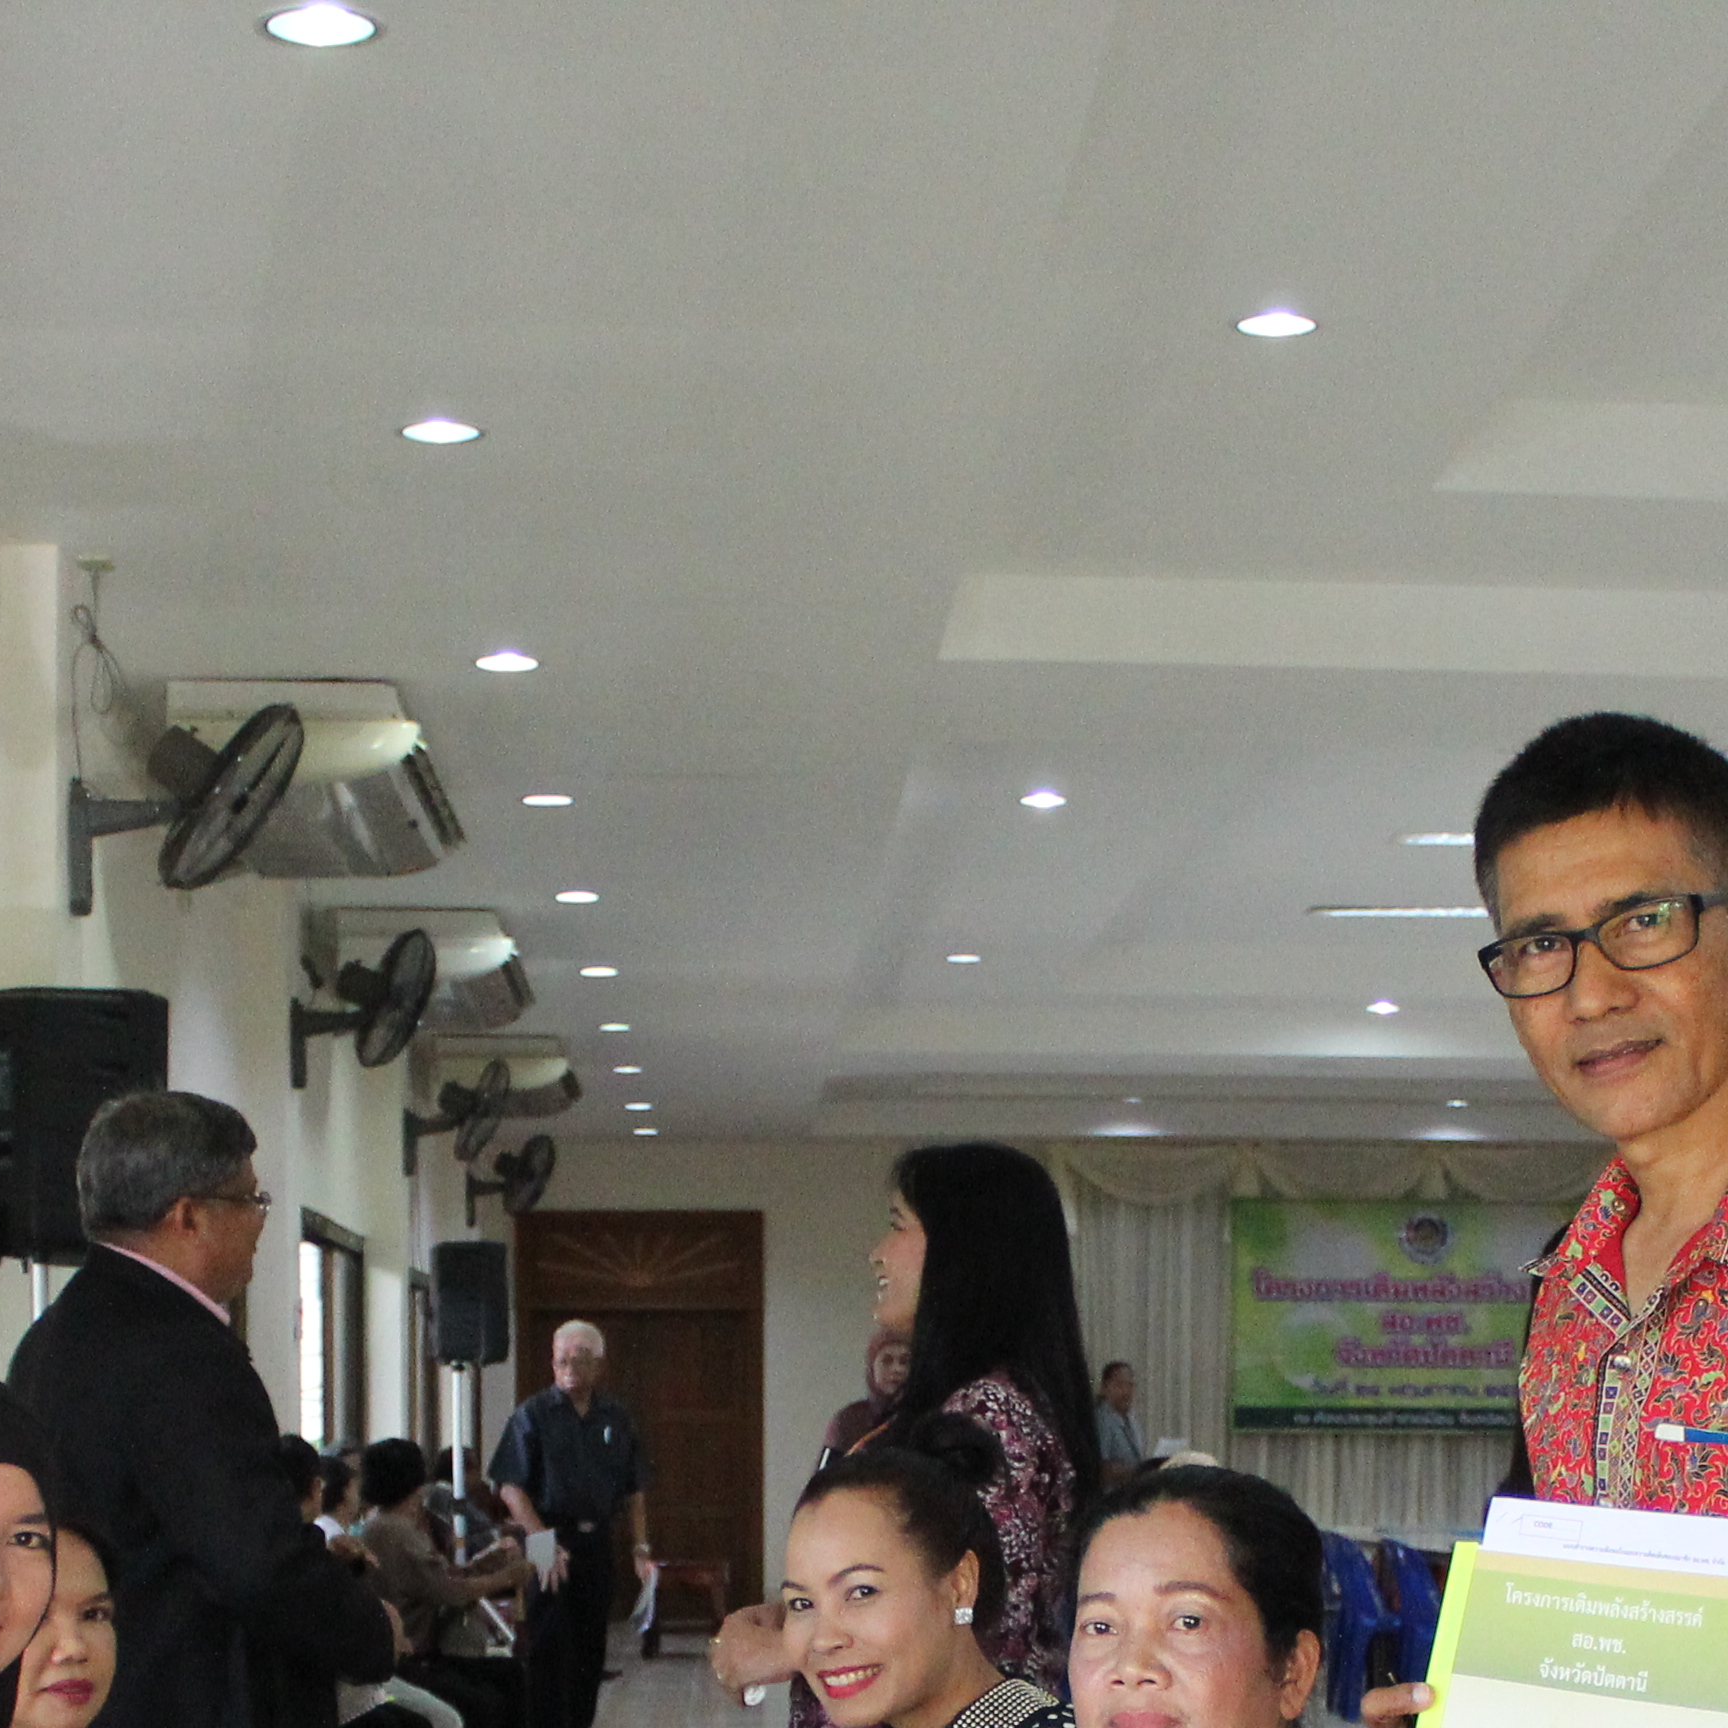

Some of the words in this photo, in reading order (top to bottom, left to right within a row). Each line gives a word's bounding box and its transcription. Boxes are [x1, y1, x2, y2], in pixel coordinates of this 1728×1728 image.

[1533, 1520, 1553, 1529] CODE
[1505, 1582, 1704, 1628] โครงการเติมพลังสร้างสรรค์
[1571, 1631, 1627, 1655] สอ.พช.
[1539, 1657, 1649, 1693] จังหวัดปัตตานี
